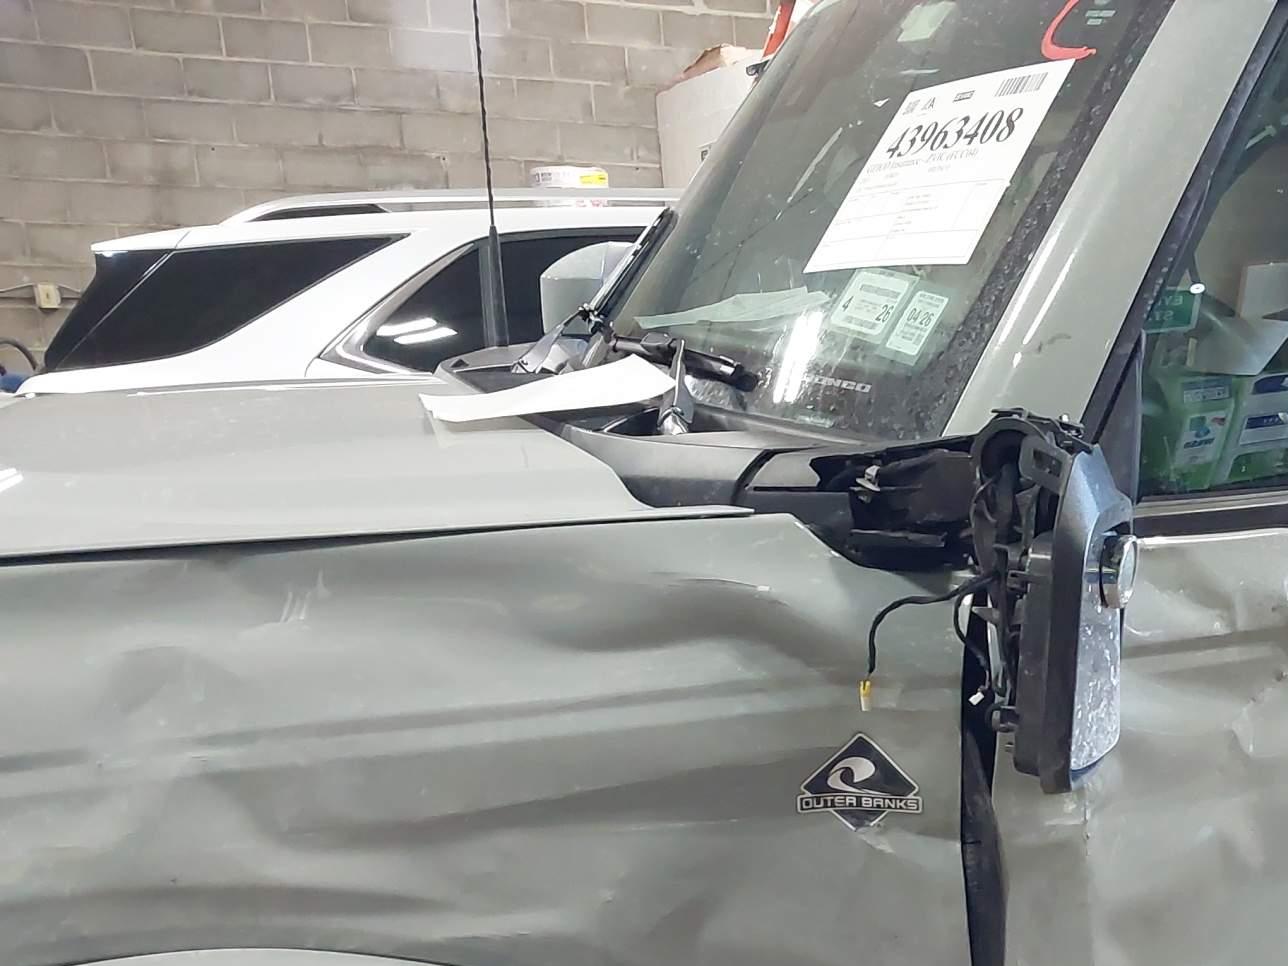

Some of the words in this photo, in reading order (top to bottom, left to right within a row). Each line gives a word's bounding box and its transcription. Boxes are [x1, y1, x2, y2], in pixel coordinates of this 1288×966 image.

[887, 107, 1024, 159] 43963408
[875, 304, 895, 324] 26
[919, 312, 935, 328] 26
[802, 796, 857, 809] OUTER
[861, 798, 918, 810] BANKS
